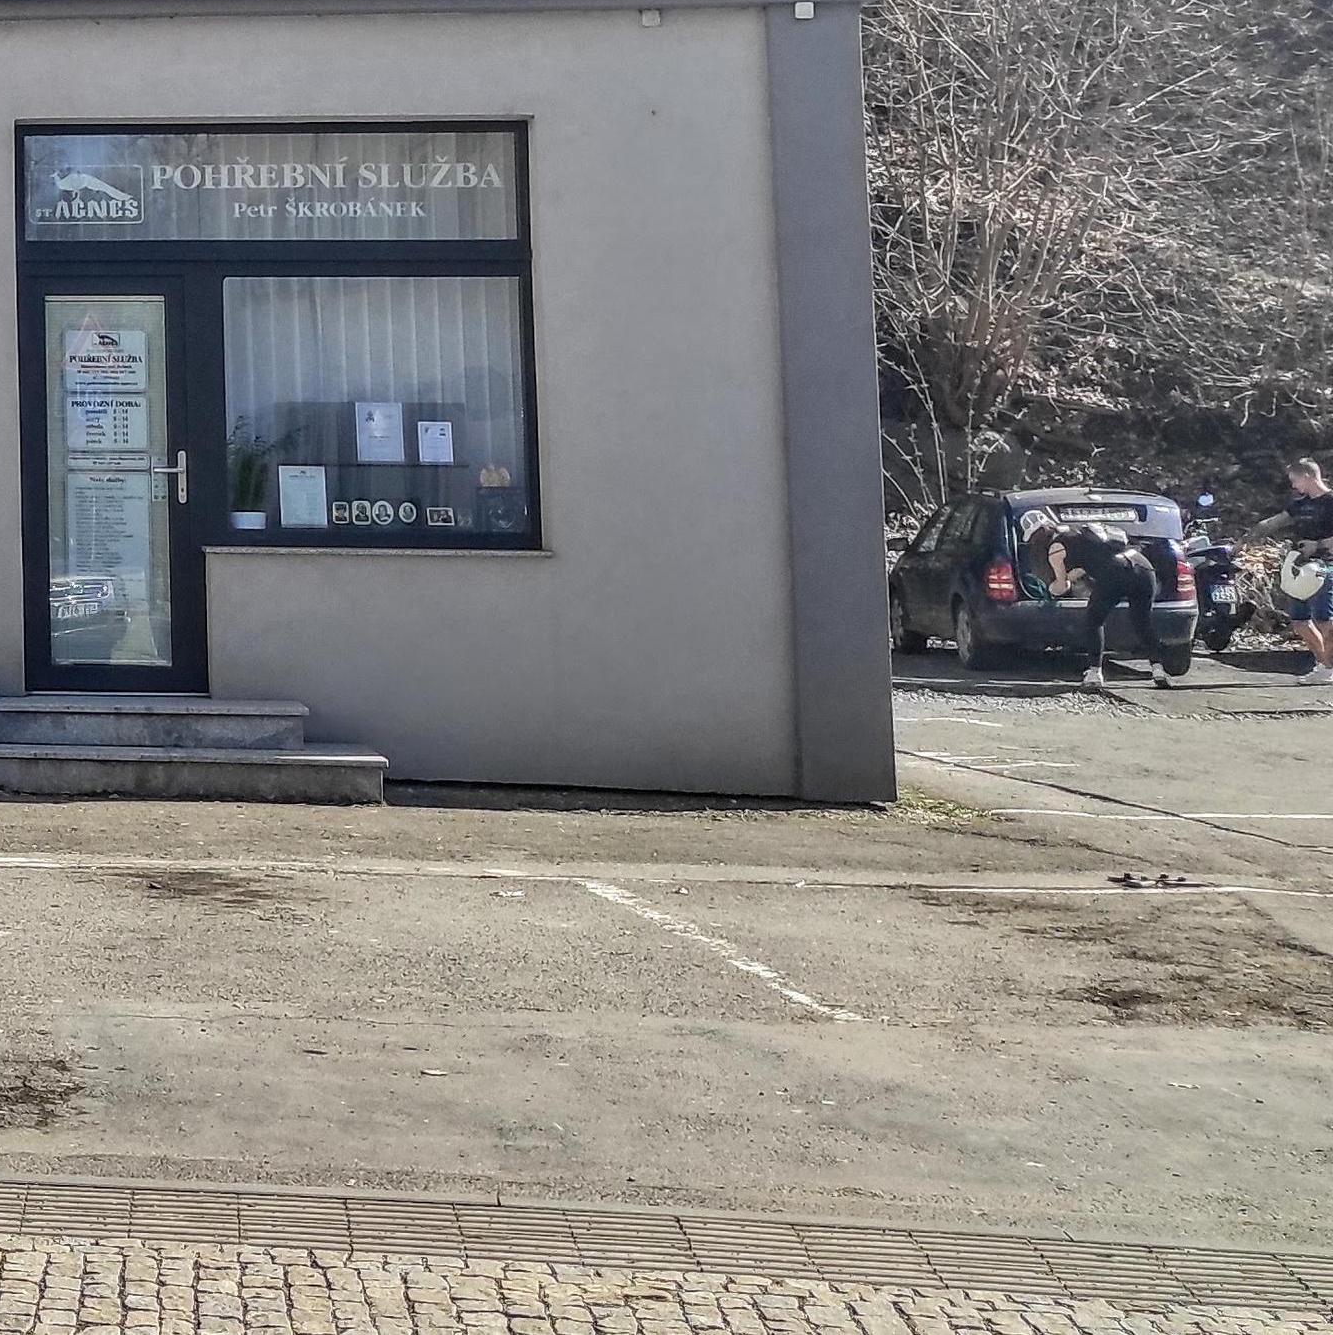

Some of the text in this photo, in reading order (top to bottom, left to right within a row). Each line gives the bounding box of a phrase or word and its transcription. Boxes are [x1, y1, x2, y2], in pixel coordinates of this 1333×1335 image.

[150, 155, 503, 190] POHŘEBNÍ SLUŽBA
[55, 198, 139, 220] AGNES
[233, 197, 428, 219] Petr ŠKROBÁNEK
